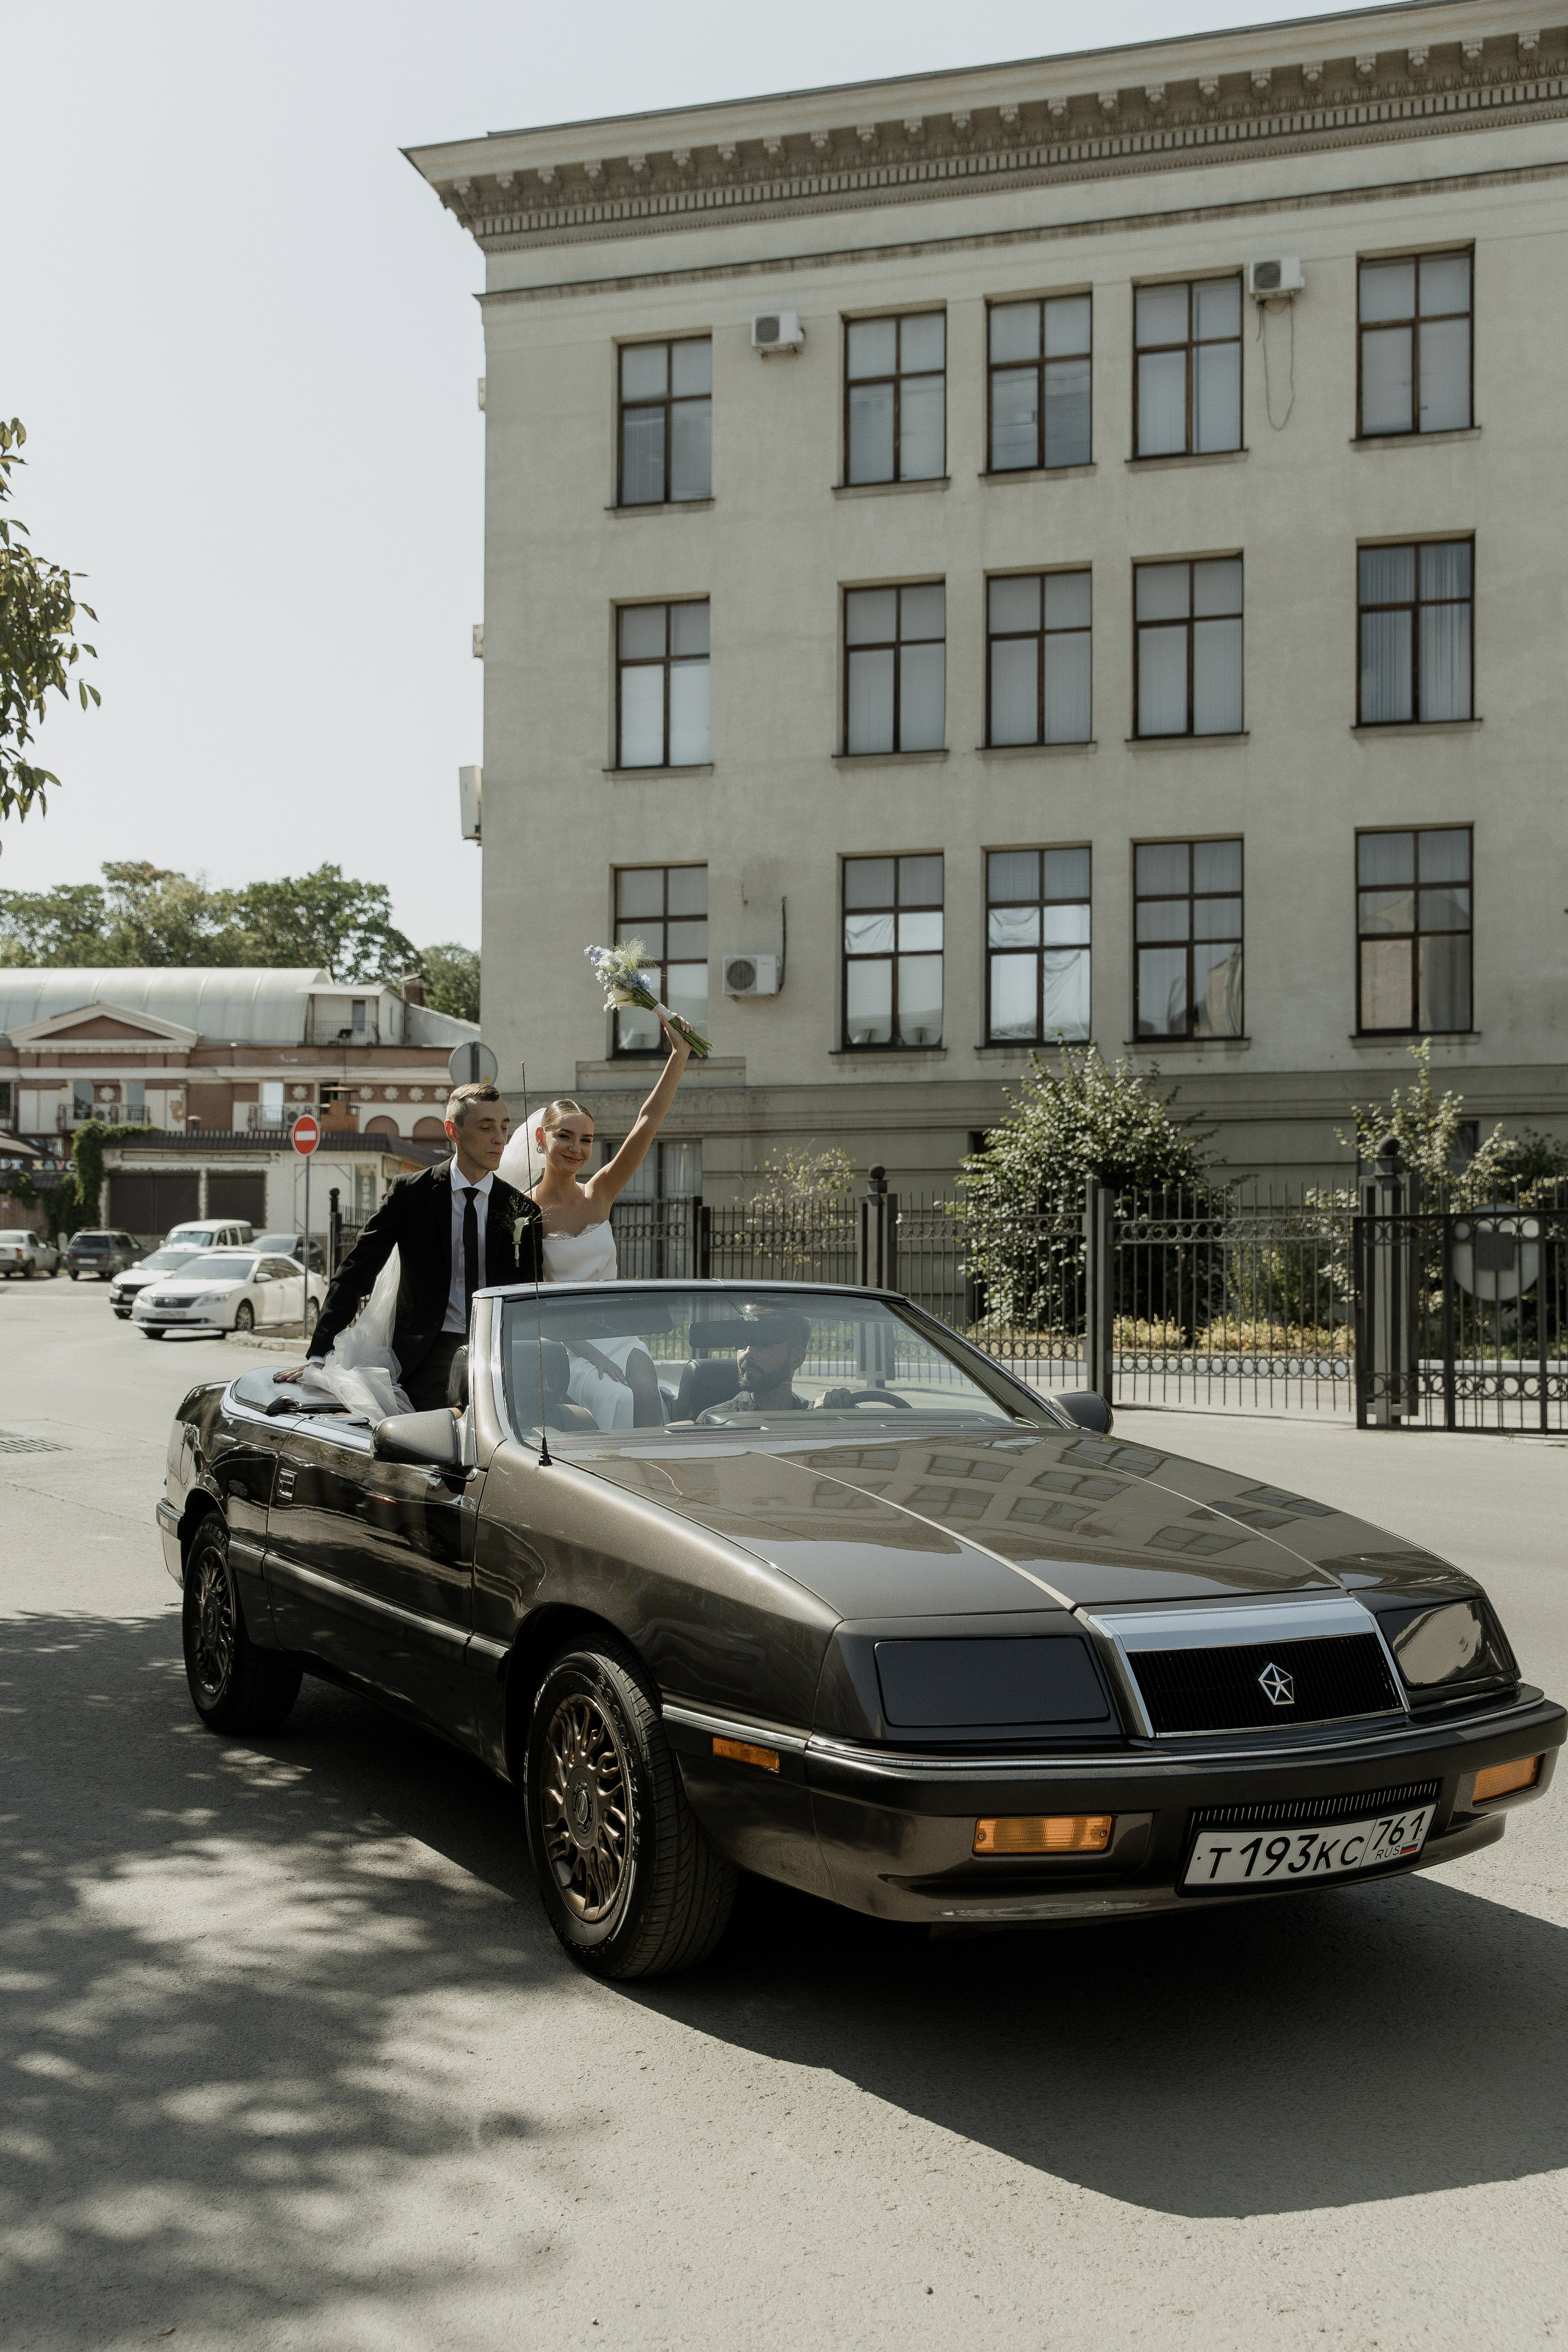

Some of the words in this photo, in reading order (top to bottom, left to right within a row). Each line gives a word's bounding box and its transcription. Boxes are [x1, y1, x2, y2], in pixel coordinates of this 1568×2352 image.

[32, 1159, 76, 1171] ХАУС
[1372, 1811, 1427, 1851] 761
[1375, 1845, 1401, 1860] RUS
